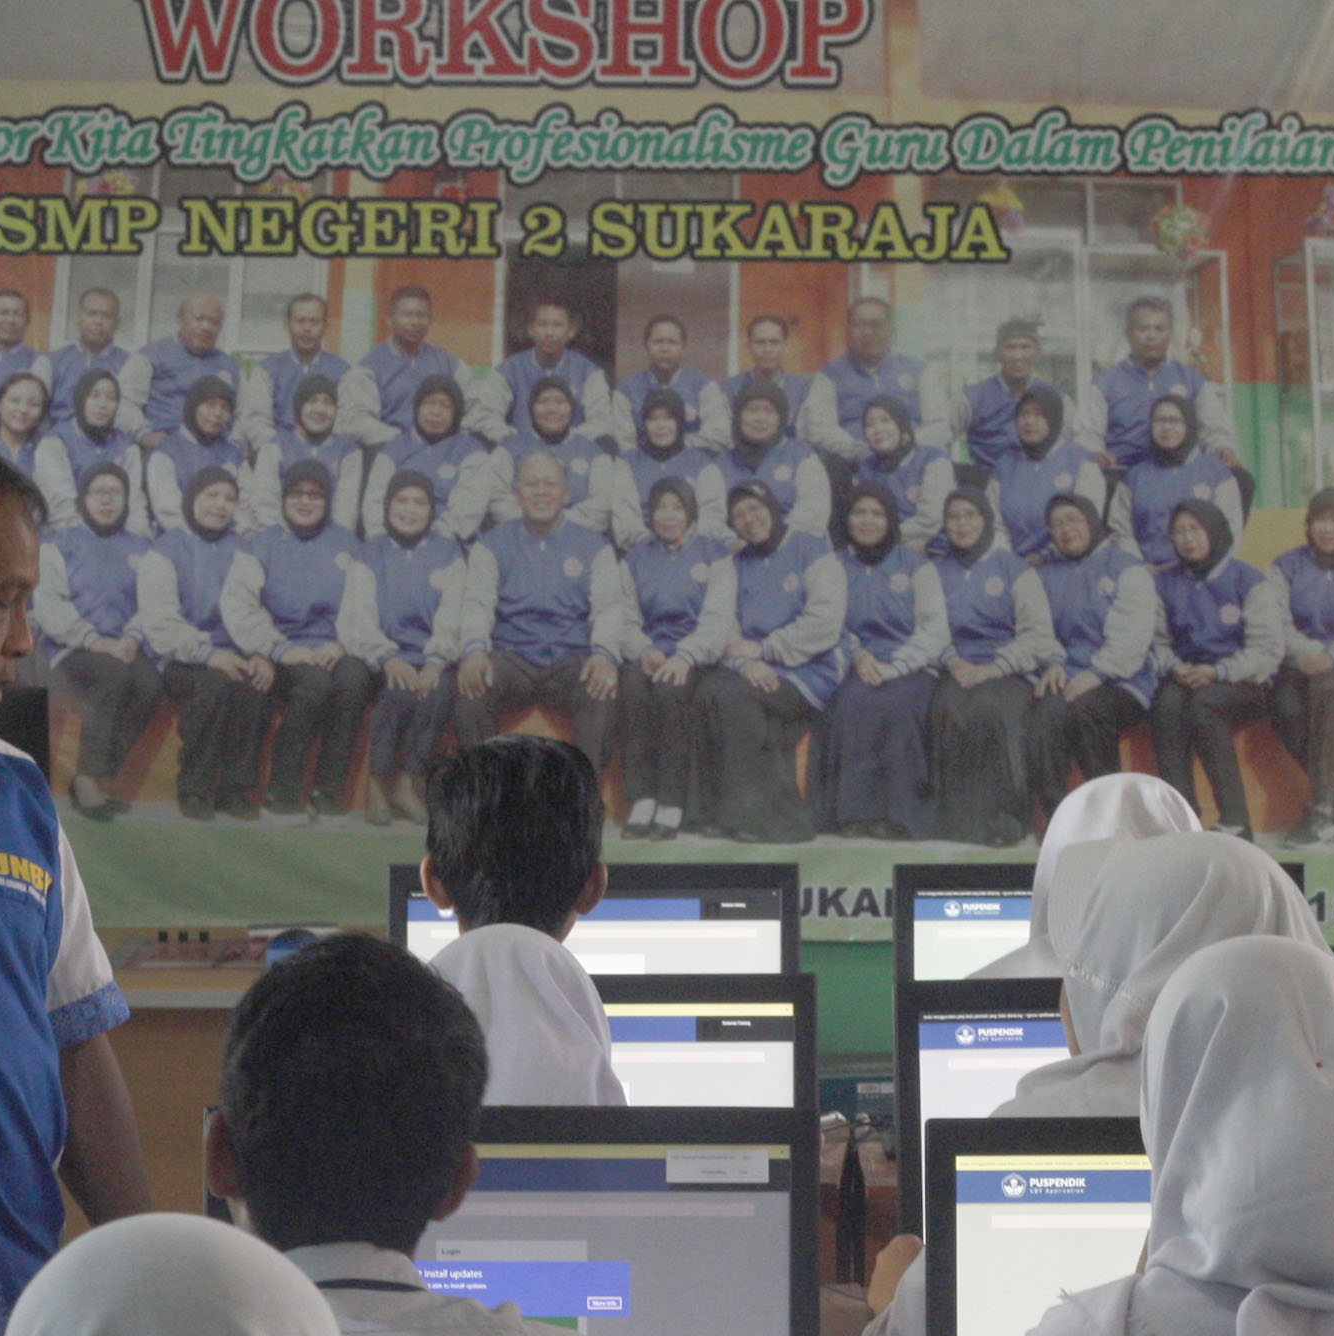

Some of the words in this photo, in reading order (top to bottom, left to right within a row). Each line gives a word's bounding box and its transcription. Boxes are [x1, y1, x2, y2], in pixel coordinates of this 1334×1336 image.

[144, 0, 871, 86] WORKSHOP
[46, 105, 160, 173] Kita
[168, 103, 440, 180] Tingkatkan
[447, 104, 814, 183] Profesionalisme
[823, 113, 948, 185] Guru
[954, 108, 1120, 172] Dalam
[180, 198, 500, 256] NEGERI
[522, 204, 565, 258] 2
[589, 201, 1008, 261] SUKARAJA
[1029, 1177, 1086, 1188] PUSPENDIK
